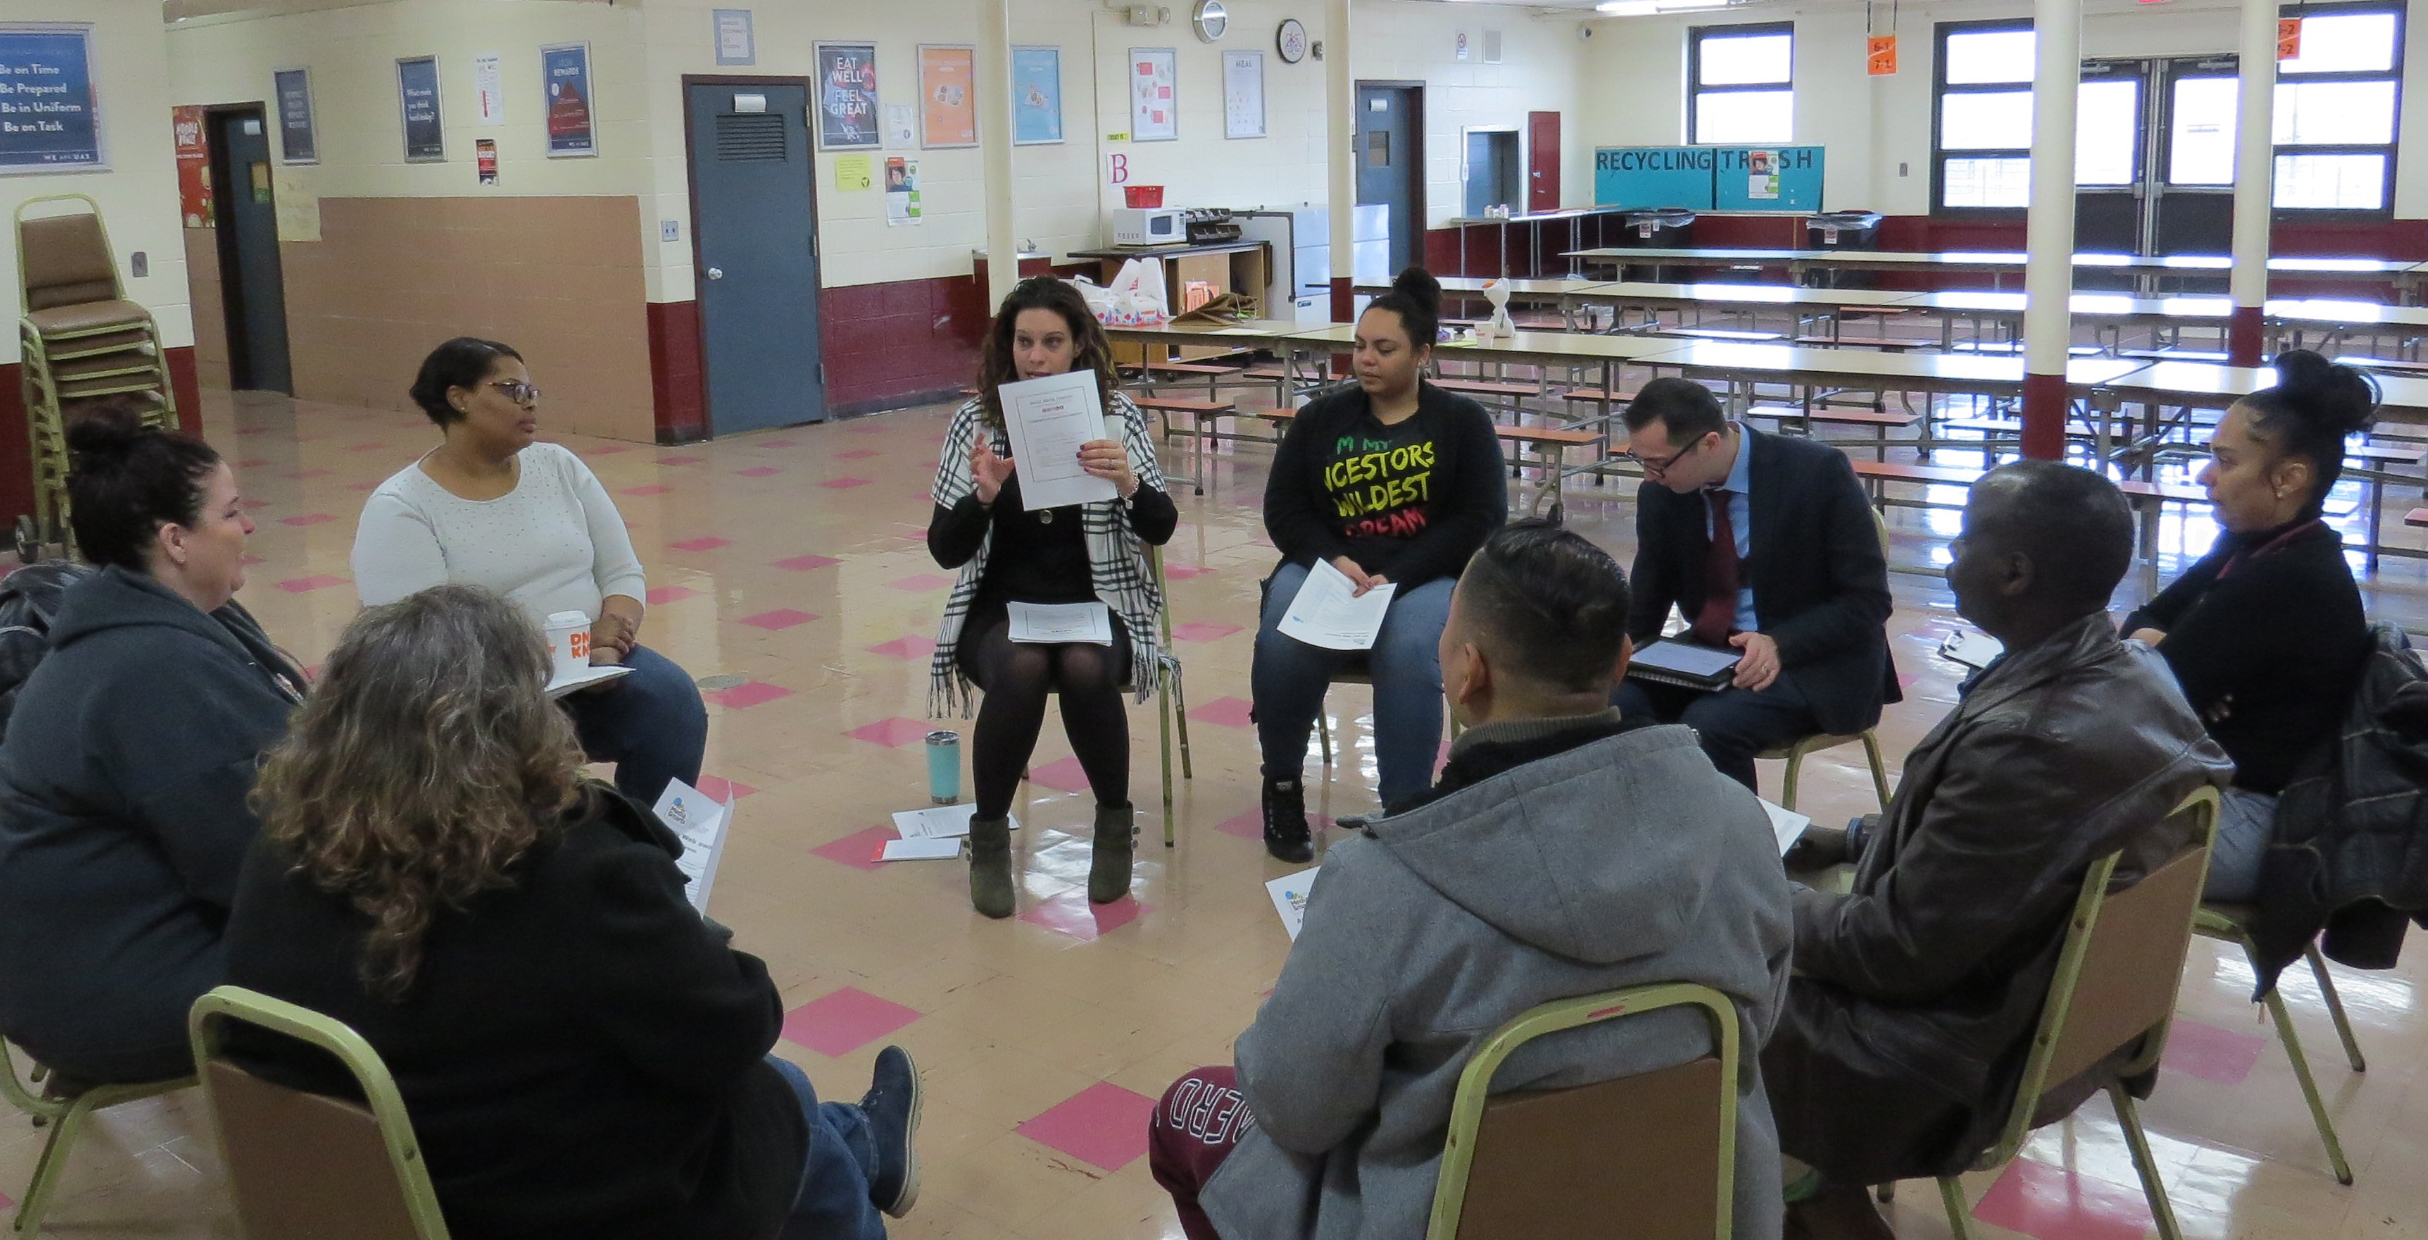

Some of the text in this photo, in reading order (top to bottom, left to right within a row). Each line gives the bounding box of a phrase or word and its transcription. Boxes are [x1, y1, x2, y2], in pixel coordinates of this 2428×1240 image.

[14, 67, 29, 75] on
[31, 63, 60, 75] Time
[836, 57, 857, 70] EAT
[832, 71, 863, 83] WELL
[0, 83, 67, 97] Be Prepared
[835, 89, 862, 102] FEEL
[1, 101, 81, 113] Be in Uniform
[830, 102, 868, 115] GREAT
[4, 120, 64, 132] Be on Task
[1596, 149, 1813, 171] RECYCLING TRSH
[1110, 153, 1129, 184] B
[1363, 438, 1392, 451] MY
[1333, 471, 1431, 517] WILDEST
